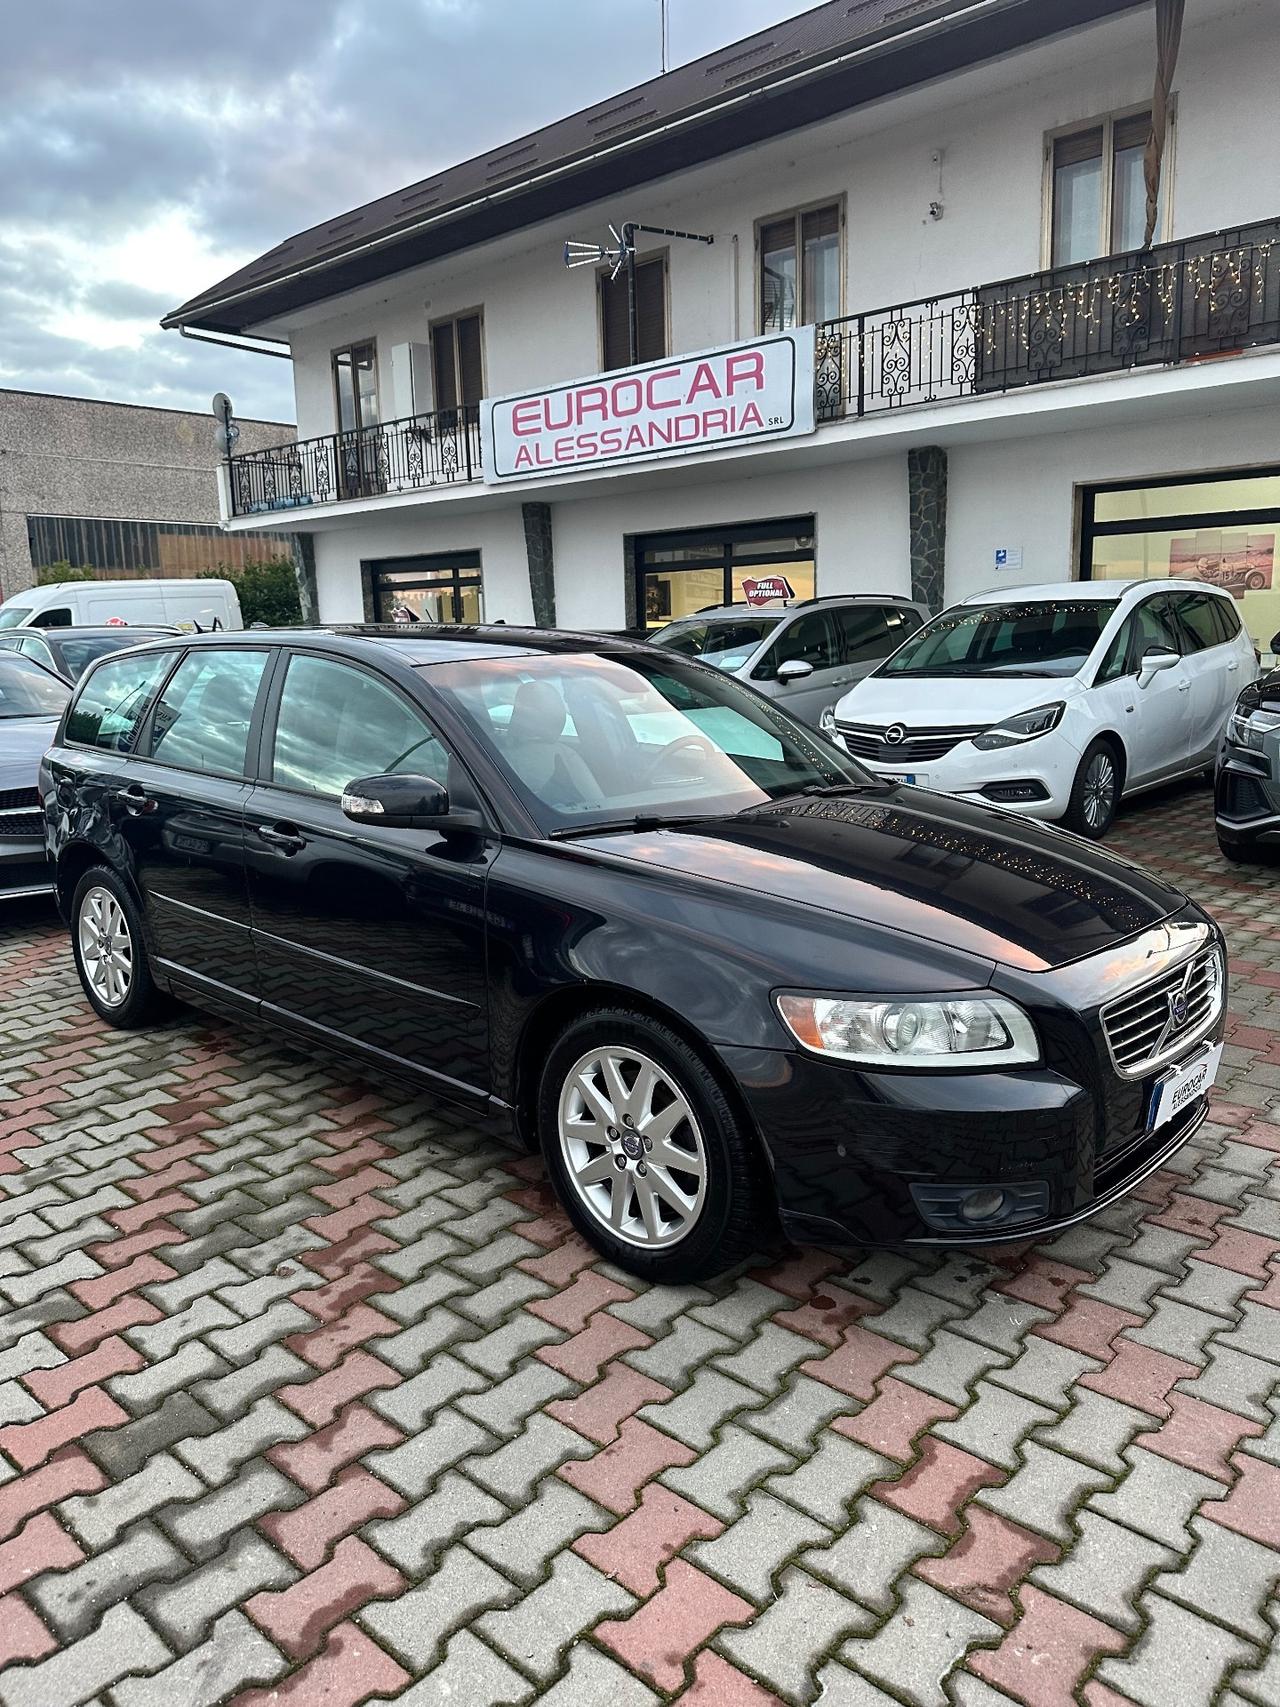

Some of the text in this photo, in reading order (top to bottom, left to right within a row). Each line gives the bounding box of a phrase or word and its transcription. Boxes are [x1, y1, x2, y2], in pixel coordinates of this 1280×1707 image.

[512, 351, 765, 437] EUROCAR
[514, 402, 784, 469] ALESSANDRIA SRL
[757, 582, 773, 590] FULL
